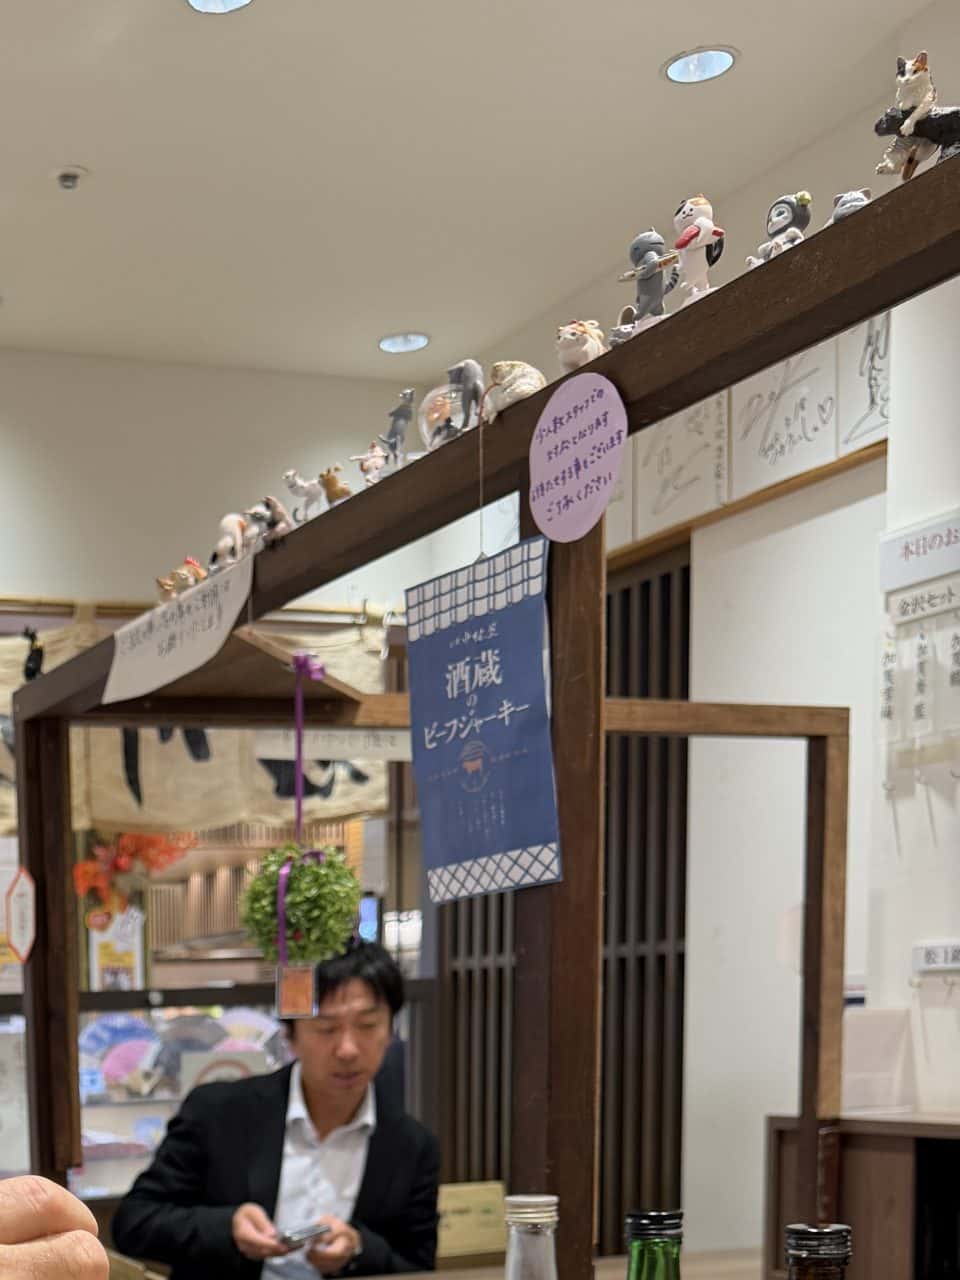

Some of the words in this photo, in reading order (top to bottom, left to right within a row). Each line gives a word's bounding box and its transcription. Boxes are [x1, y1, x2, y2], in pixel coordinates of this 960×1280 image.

[445, 649, 503, 699] 酒蔵
[465, 692, 478, 707] の
[423, 700, 531, 750] ビーフジャーキー
